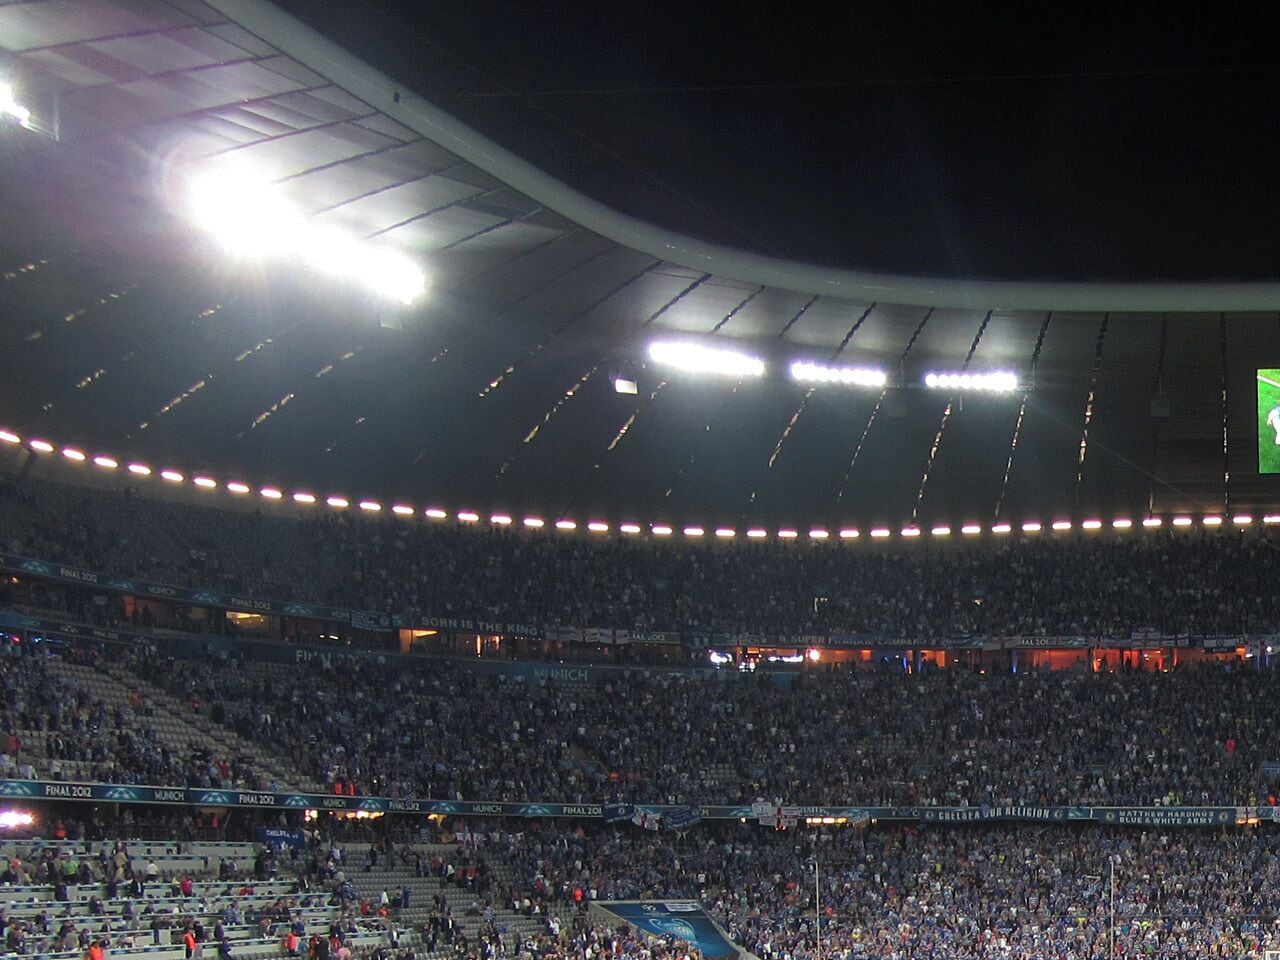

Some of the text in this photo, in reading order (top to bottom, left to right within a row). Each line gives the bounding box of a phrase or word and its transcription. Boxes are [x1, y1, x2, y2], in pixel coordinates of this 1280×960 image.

[421, 616, 458, 629] BORN
[461, 619, 474, 630] IS
[476, 621, 503, 633] THE
[533, 666, 589, 683] MUNICH
[45, 785, 93, 798] FINAL 2012
[154, 790, 185, 801] MUNICH
[238, 794, 275, 805] FINAL 2012
[473, 804, 503, 814] MUNICH
[563, 806, 585, 815] FINAL
[938, 811, 980, 821] CHELSEA
[1005, 806, 1050, 819] RELIGION
[1186, 817, 1215, 825] ARMY
